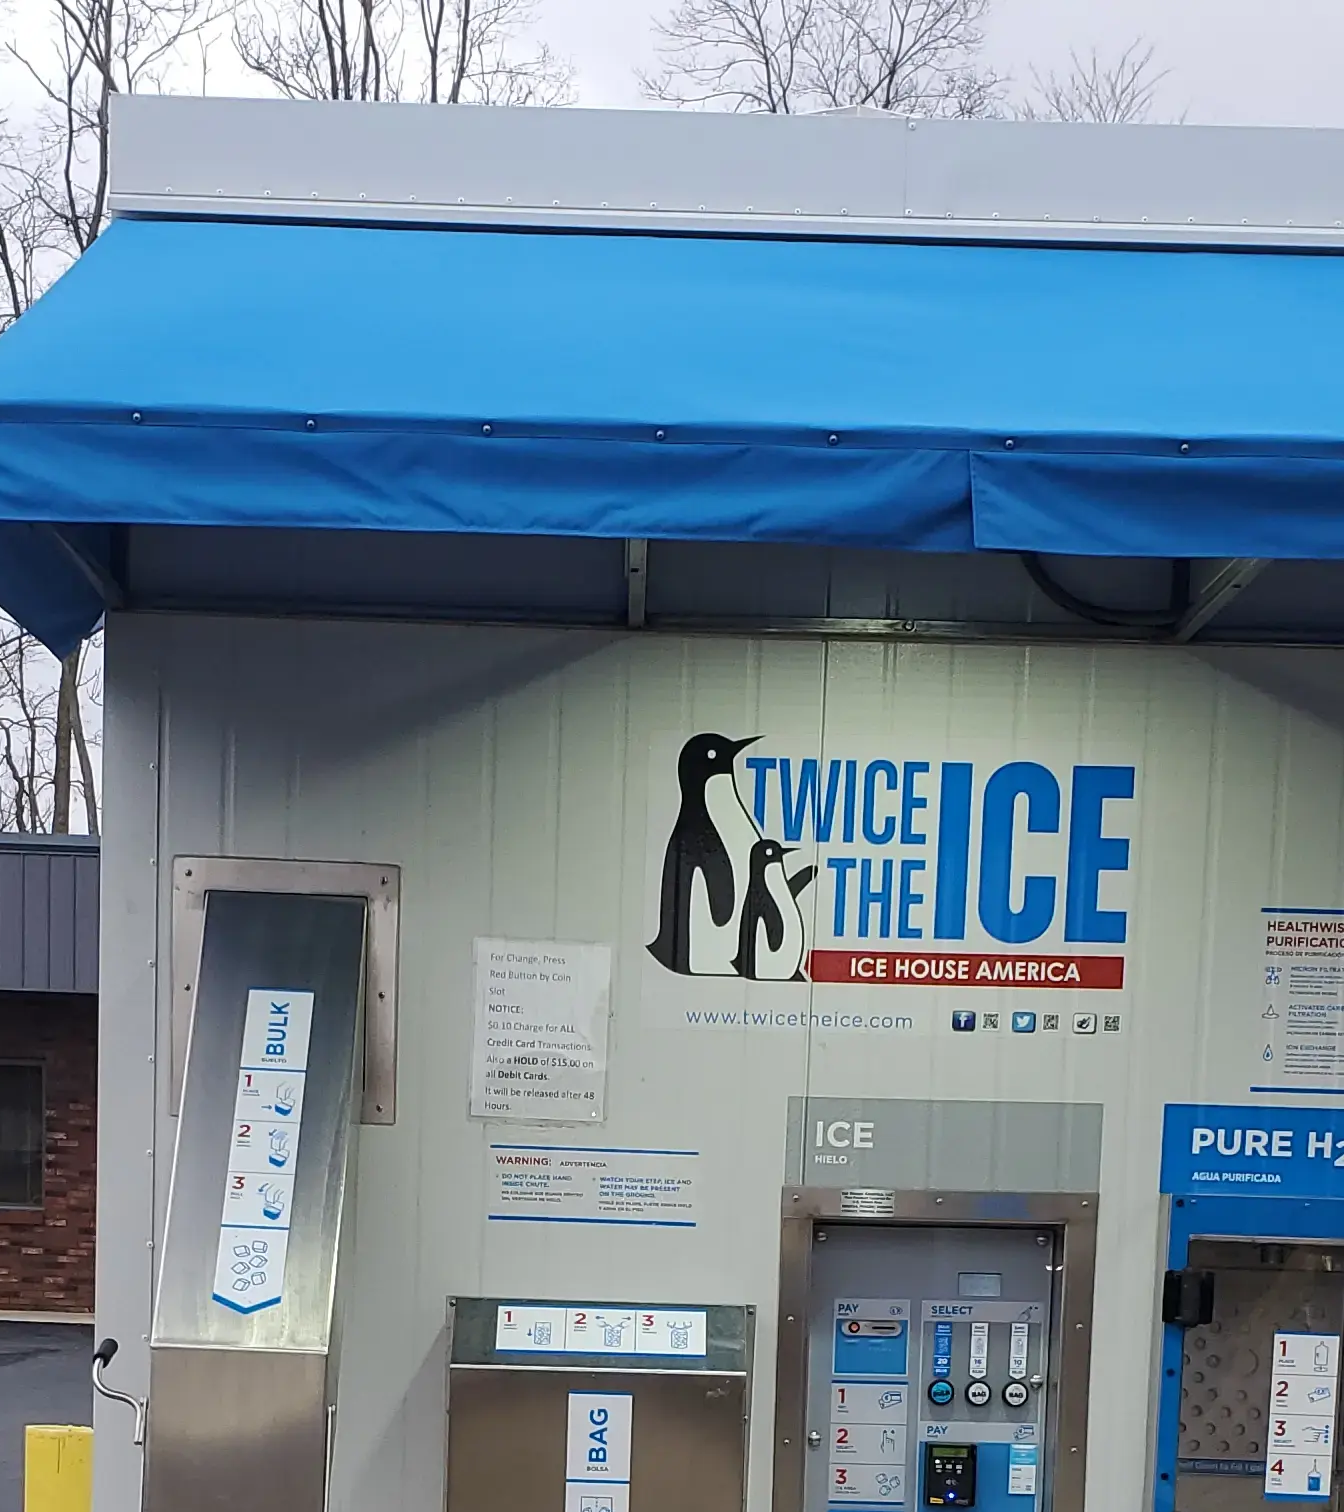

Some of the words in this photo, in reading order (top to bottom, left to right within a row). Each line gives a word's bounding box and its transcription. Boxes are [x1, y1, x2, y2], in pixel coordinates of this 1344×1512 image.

[746, 757, 929, 844] TWICE
[933, 761, 1136, 944] ICE
[826, 857, 927, 939] THE
[490, 953, 504, 961] For
[507, 954, 540, 965] Change,
[543, 956, 566, 964] Press
[850, 957, 887, 978] ICE
[894, 959, 970, 980] HOUSE
[976, 960, 1081, 982] AMERICA
[509, 972, 537, 980] Button
[540, 973, 550, 982] by
[552, 973, 571, 982] Coin
[686, 1008, 913, 1030] www.twicetheice.com
[266, 1001, 290, 1055] BULK
[514, 1023, 543, 1032] Charge
[545, 1024, 558, 1032] for
[560, 1025, 575, 1033] ALL
[487, 1039, 513, 1047] Credit
[516, 1040, 535, 1048] Card
[514, 1057, 538, 1065] HOLD
[540, 1058, 549, 1066] of
[551, 1058, 580, 1067] $15.00
[244, 1074, 253, 1087] 1
[486, 1071, 495, 1079] all
[498, 1071, 521, 1079] Debit
[524, 1072, 550, 1080] Cards.
[494, 1088, 508, 1096] will
[510, 1088, 521, 1096] be
[524, 1089, 559, 1098] released
[561, 1090, 581, 1099] after
[485, 1102, 511, 1110] Hours.
[237, 1125, 251, 1138] 2
[815, 1120, 874, 1148] ICE
[1192, 1128, 1293, 1157] PURE
[496, 1156, 552, 1167] WARNING:
[815, 1155, 847, 1164] HIELO
[232, 1176, 245, 1189] 3
[1192, 1172, 1220, 1181] AGUA
[1222, 1173, 1281, 1184] PURIFICADA
[838, 1303, 859, 1313] PAY
[931, 1306, 973, 1315] SELECT
[504, 1311, 512, 1322] 1
[574, 1313, 586, 1325] 2
[642, 1315, 654, 1327] 3
[1280, 1341, 1287, 1356] 1
[1276, 1381, 1288, 1396] 2
[838, 1388, 845, 1403] 1
[927, 1426, 948, 1434] PAY
[1274, 1420, 1286, 1436] 3
[589, 1408, 608, 1462] BAG
[837, 1429, 848, 1443] 2
[1270, 1460, 1284, 1475] 4
[835, 1469, 847, 1484] 3
